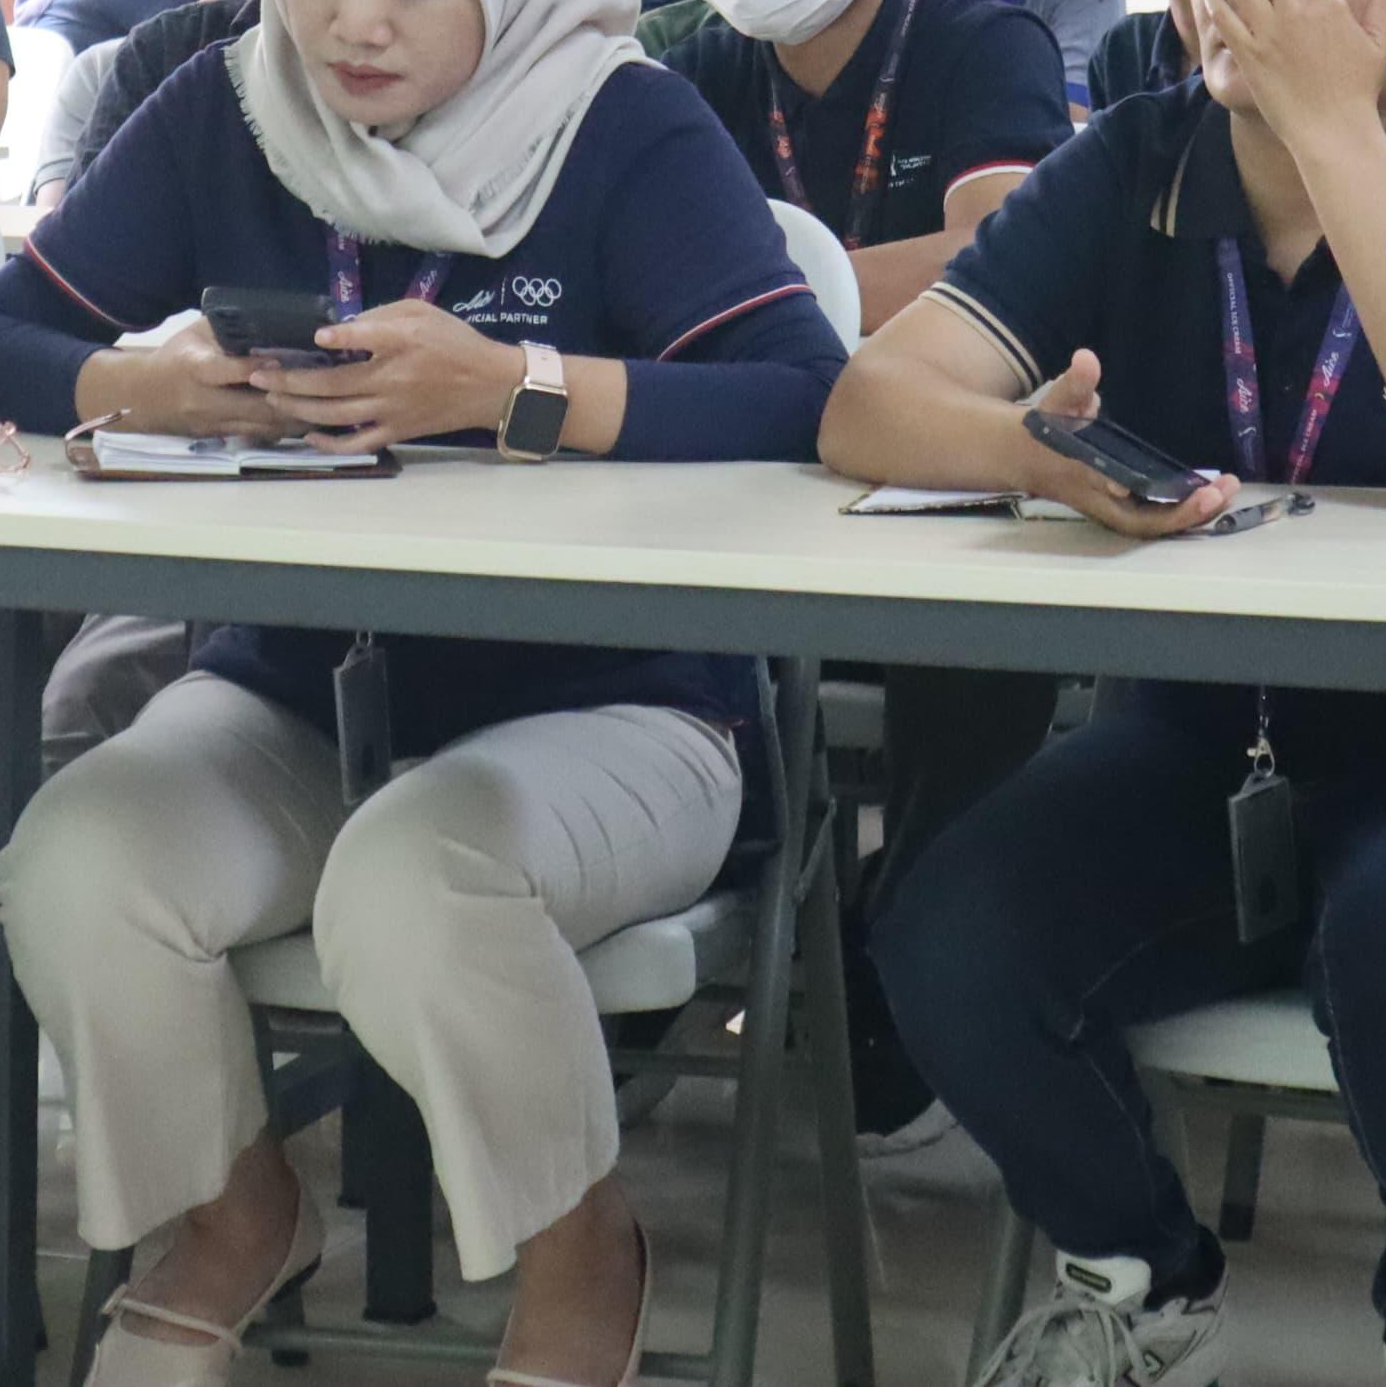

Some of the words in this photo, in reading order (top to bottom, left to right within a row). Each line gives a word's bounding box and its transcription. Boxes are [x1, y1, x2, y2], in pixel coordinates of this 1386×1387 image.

[499, 311, 550, 325] PARTNER
[1321, 350, 1341, 388] Aice
[1236, 377, 1254, 414] Aice
